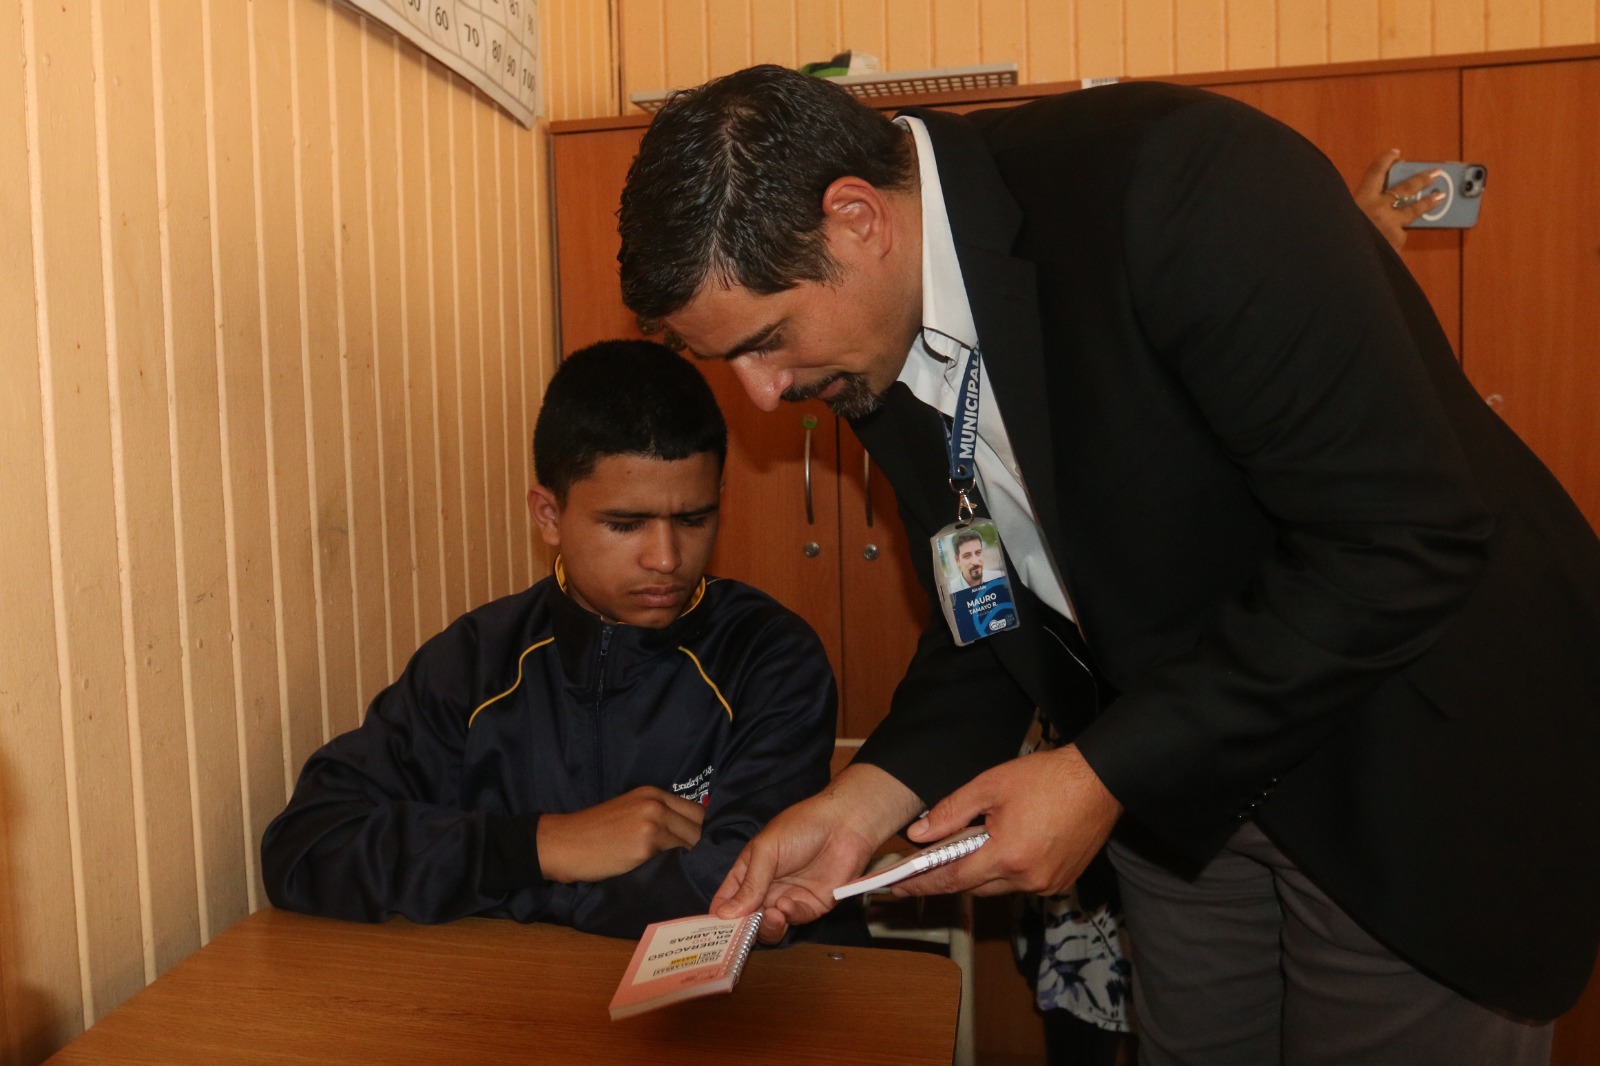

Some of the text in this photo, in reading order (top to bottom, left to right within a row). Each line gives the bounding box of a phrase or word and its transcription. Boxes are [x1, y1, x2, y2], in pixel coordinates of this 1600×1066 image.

[435, 6, 449, 31] 60
[464, 23, 480, 47] 70
[492, 40, 501, 63] 80
[507, 55, 516, 77] 90
[966, 592, 997, 608] MAURO
[968, 603, 992, 615] TAMAYO
[669, 928, 734, 945] PALABRAS
[648, 939, 729, 961] CIBERACOSO
